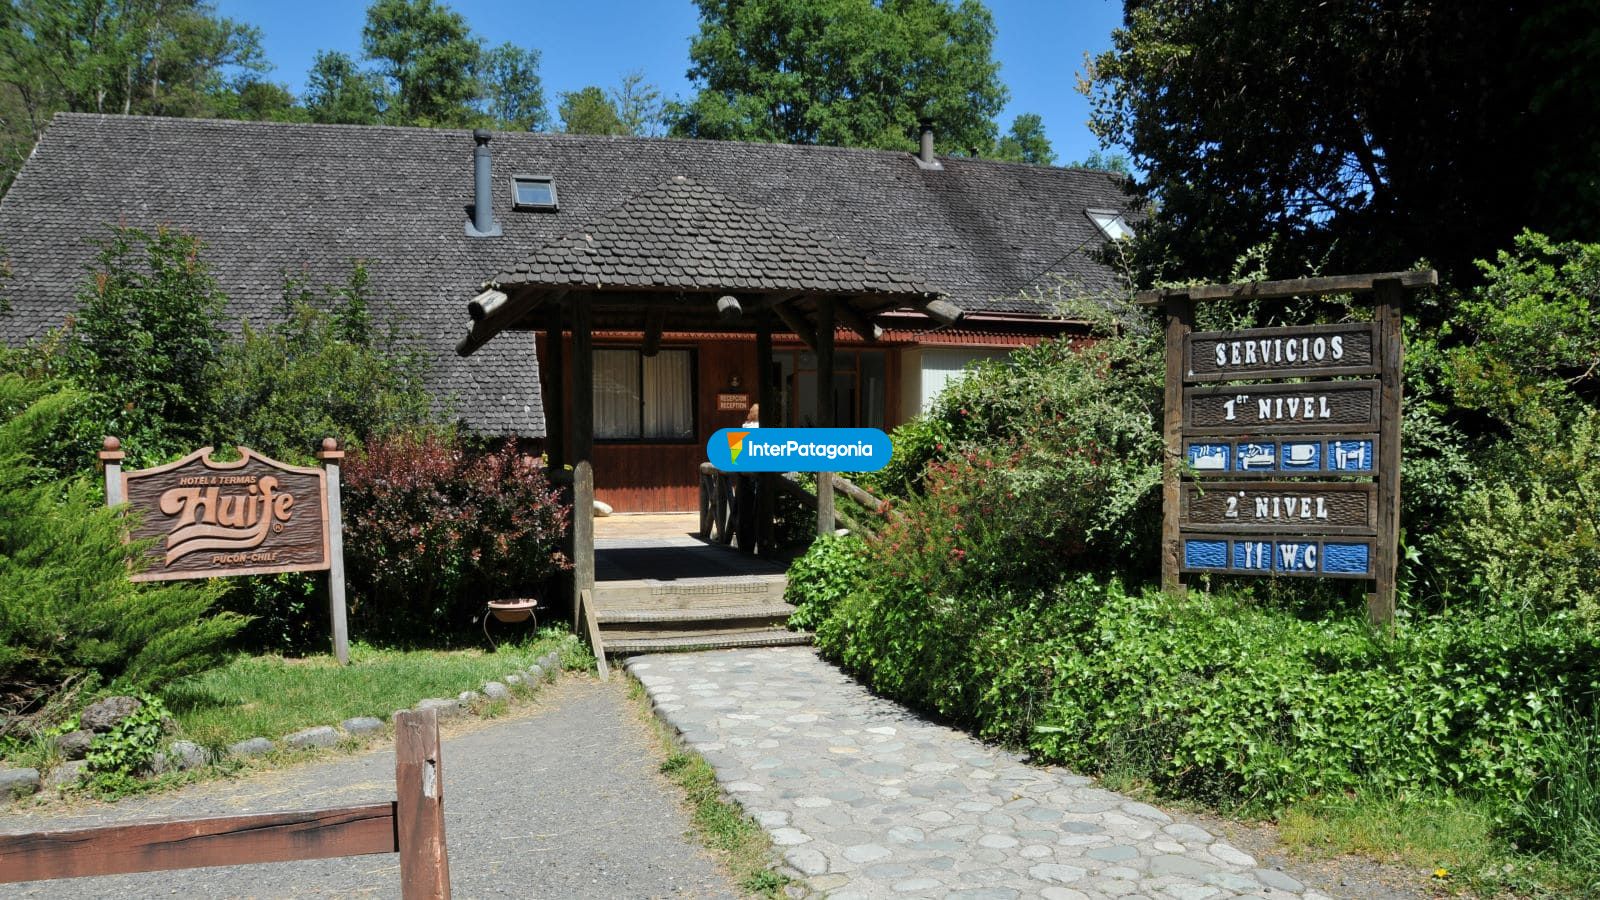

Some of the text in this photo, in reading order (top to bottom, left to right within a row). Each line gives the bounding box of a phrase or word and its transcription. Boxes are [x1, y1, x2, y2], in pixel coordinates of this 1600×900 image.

[1215, 335, 1344, 366] SERVICIOS
[1258, 396, 1331, 419] NIVEL
[180, 475, 257, 485] HOTEL & TERMAS
[159, 475, 295, 536] Huife
[1255, 497, 1327, 519] NIVEL
